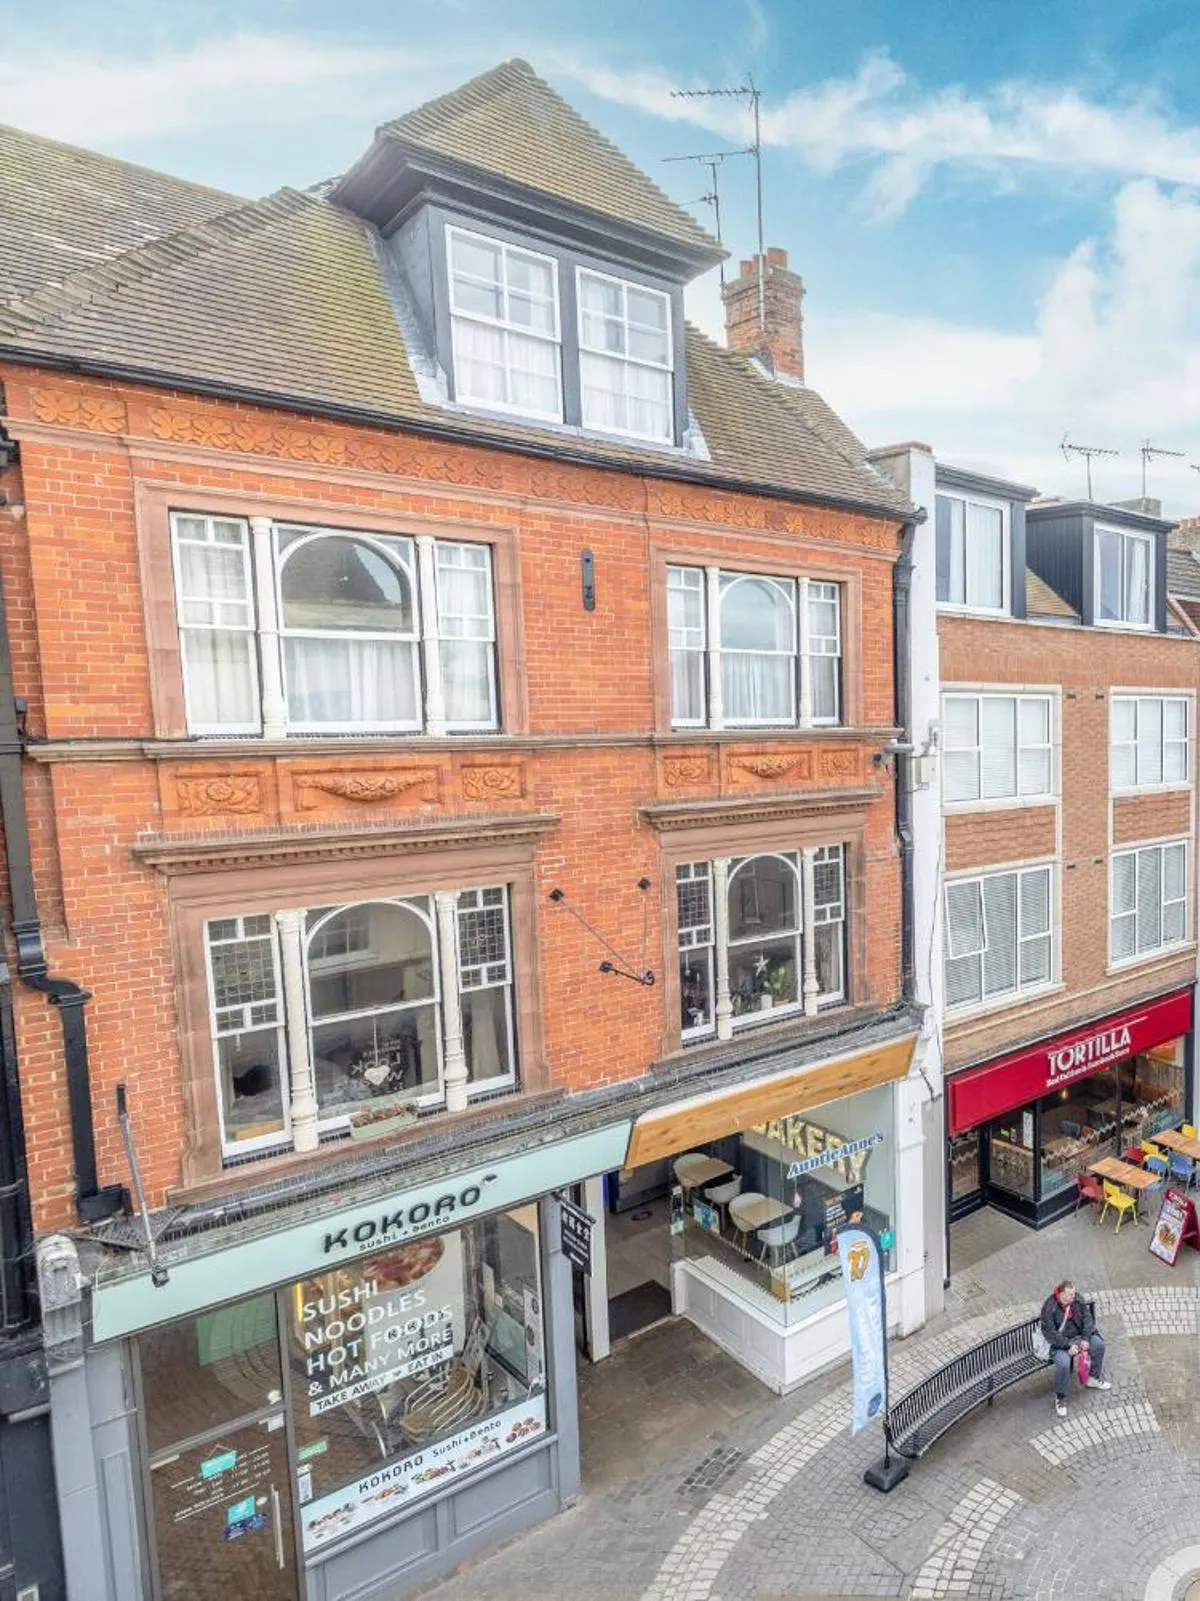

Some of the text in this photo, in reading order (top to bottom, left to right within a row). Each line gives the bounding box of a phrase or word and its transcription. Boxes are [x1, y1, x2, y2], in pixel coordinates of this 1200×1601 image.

[1047, 1027, 1132, 1077] TORTILLA
[323, 1186, 482, 1253] KOKORO
[303, 1279, 379, 1322] SUSHI
[304, 1289, 427, 1350] NOODLES
[306, 1339, 362, 1376] HOT
[370, 1304, 453, 1350] FOODS
[307, 1328, 452, 1397] & MANY MORE
[316, 1351, 444, 1411] TAKE AWAY EAT IN
[358, 1455, 424, 1494] KOKORO
